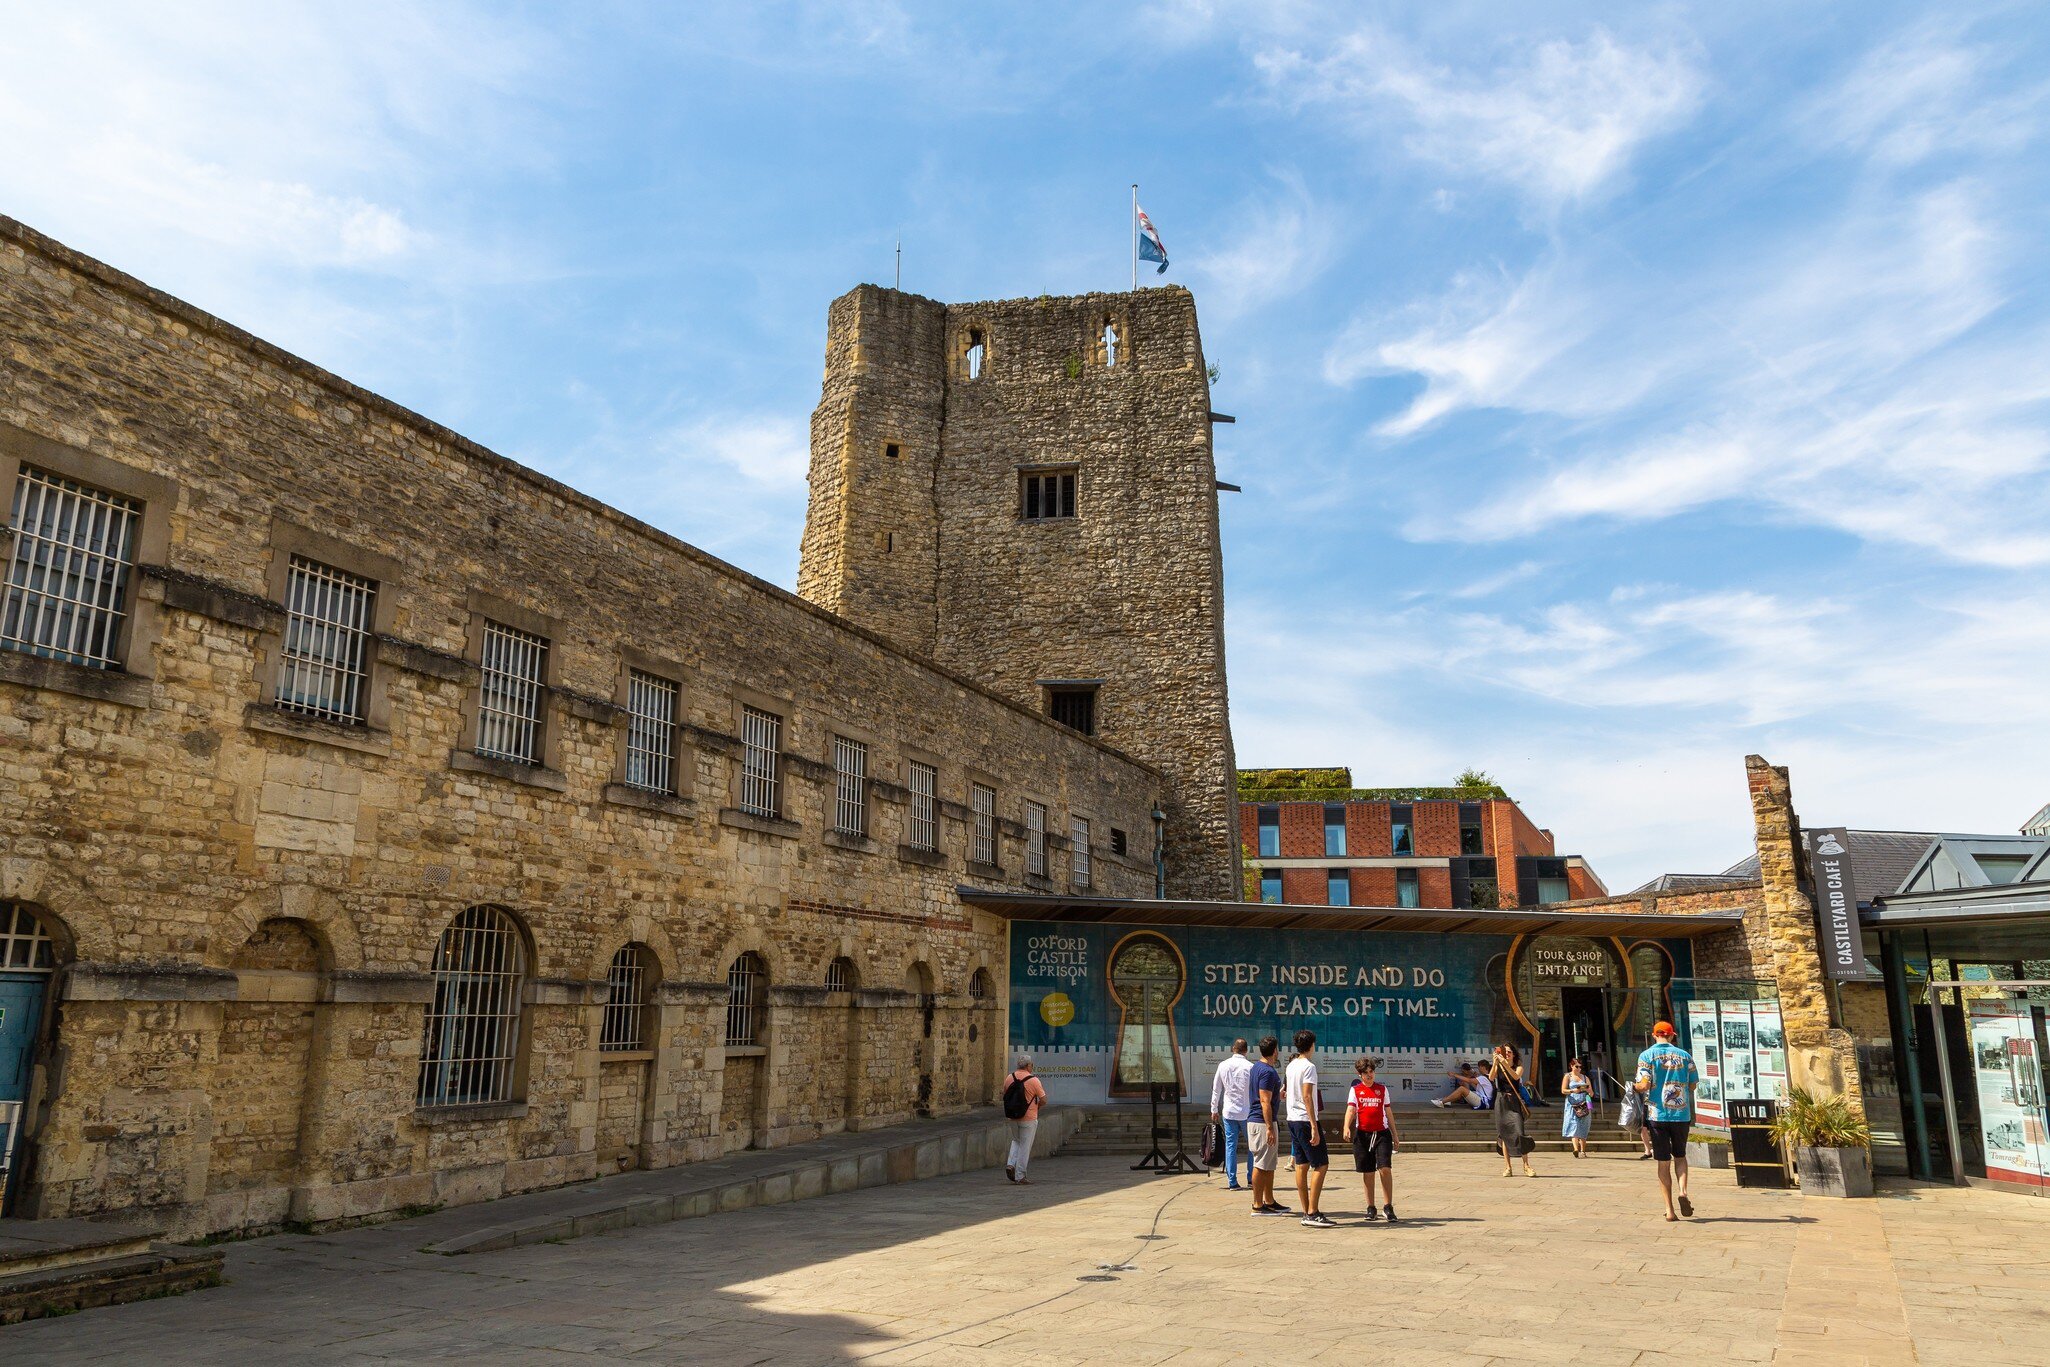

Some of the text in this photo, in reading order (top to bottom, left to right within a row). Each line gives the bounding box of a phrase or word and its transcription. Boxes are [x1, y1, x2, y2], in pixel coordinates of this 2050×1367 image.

[1821, 860, 1853, 965] CASTLEYARD CAFÉ
[1028, 935, 1088, 951] OXFORD
[1027, 950, 1088, 965] CASTLE
[1536, 950, 1602, 962] TOUR & SHOP
[1204, 963, 1445, 987] STEP INSIDE AND DO
[1537, 964, 1603, 976] ENTRANCE
[1202, 994, 1456, 1018] 1,000 YEARS OF TIME...
